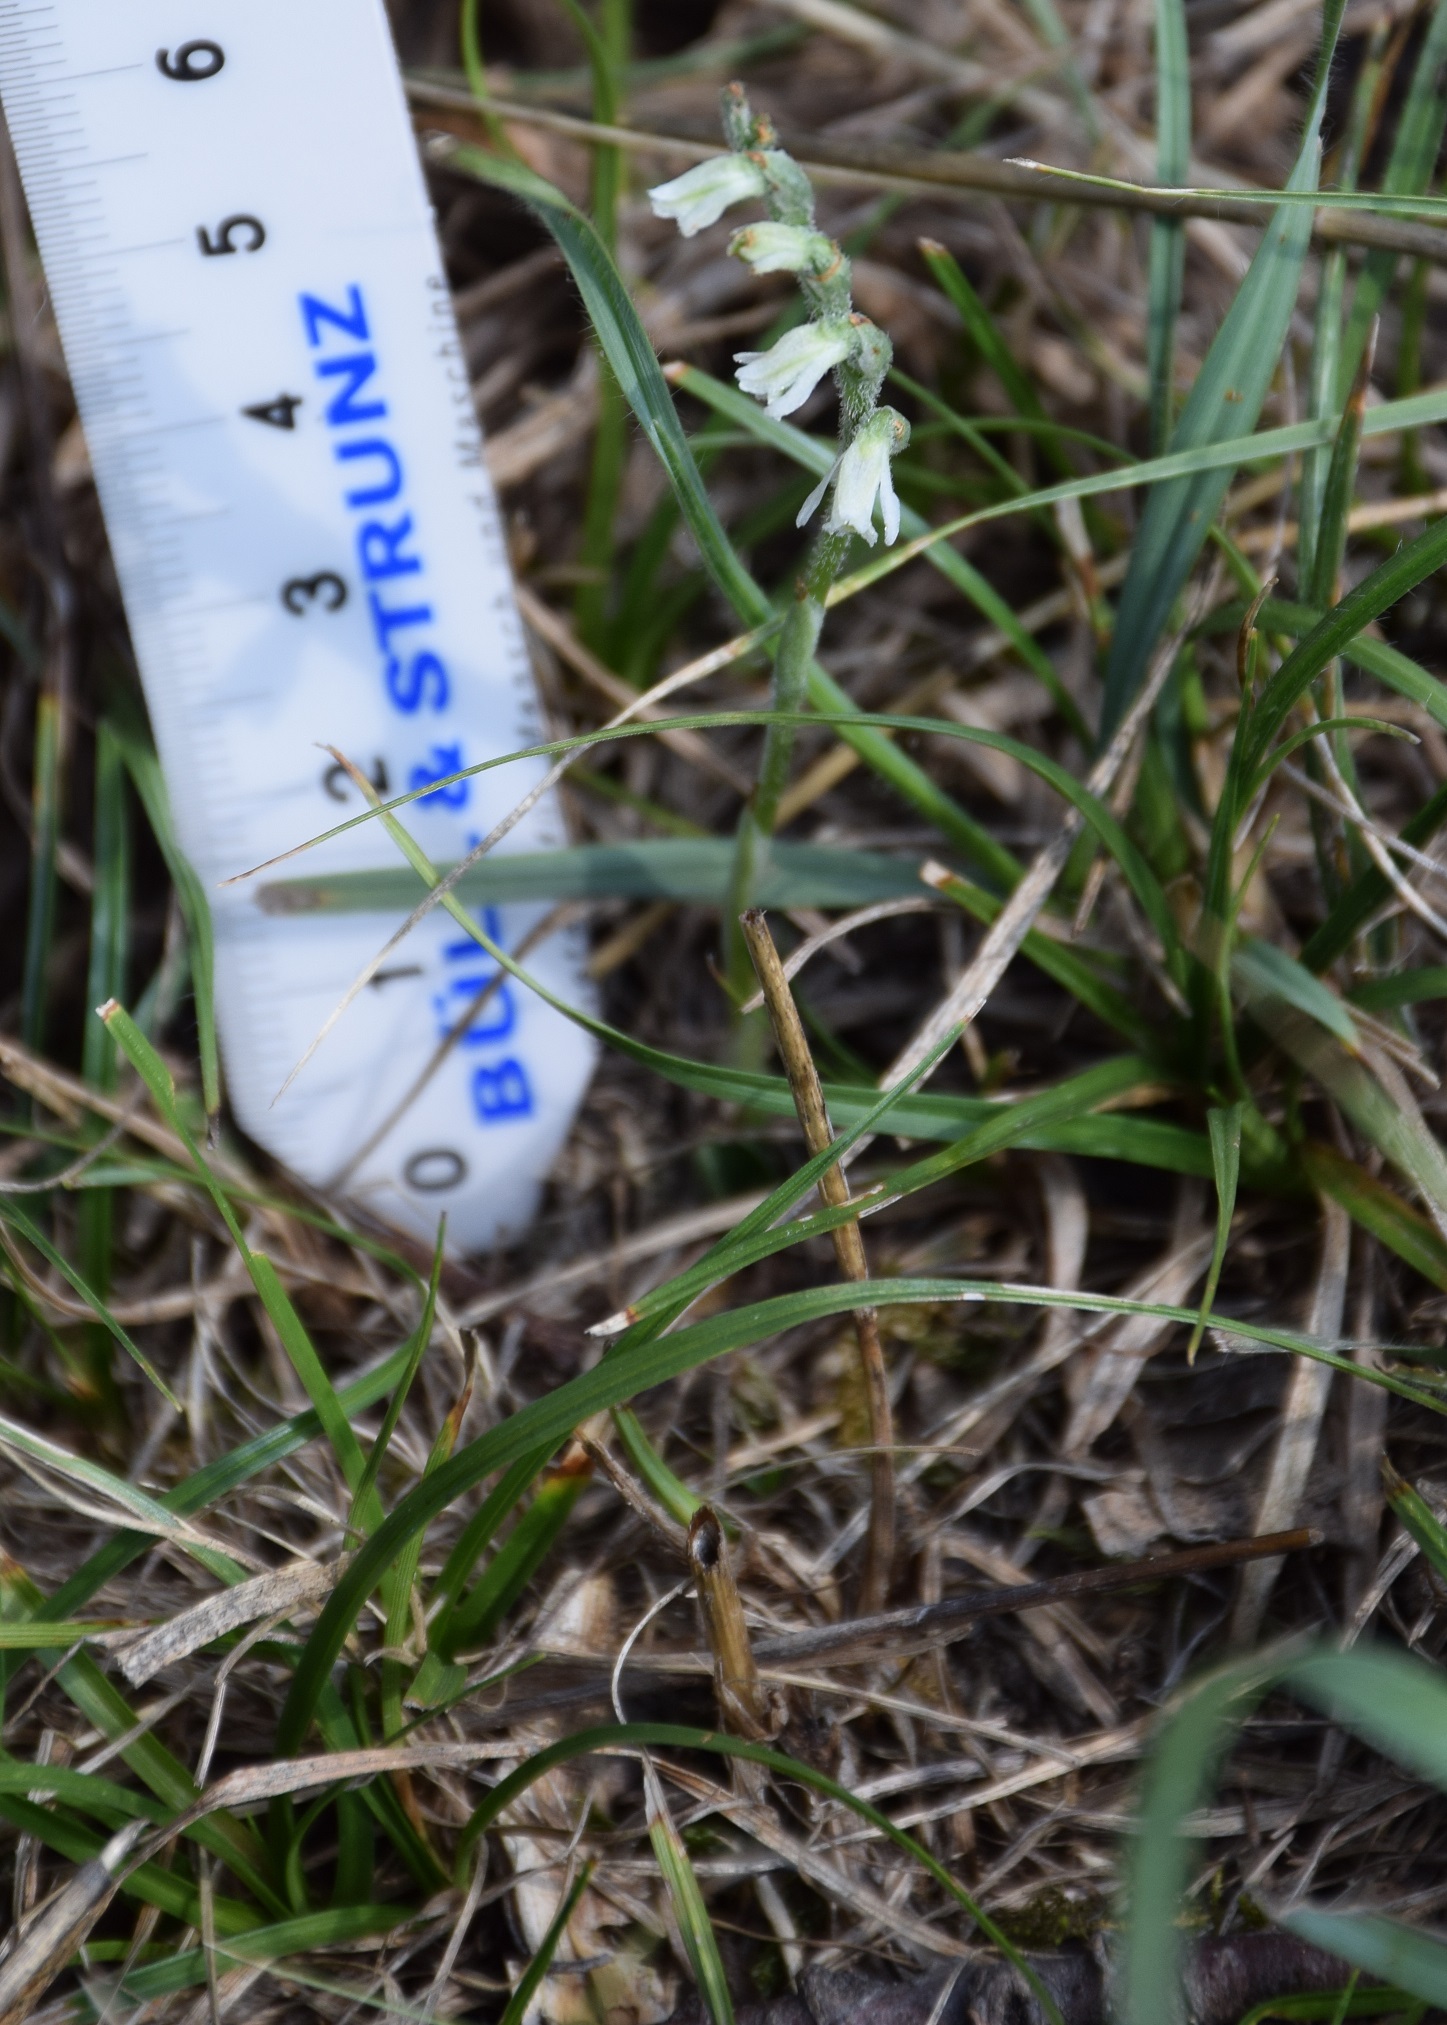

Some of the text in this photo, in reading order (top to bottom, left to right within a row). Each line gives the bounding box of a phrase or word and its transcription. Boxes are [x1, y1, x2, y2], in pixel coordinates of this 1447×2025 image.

[155, 38, 227, 83] 6
[196, 213, 267, 257] 5
[241, 392, 304, 432] 4
[280, 570, 349, 617] 3
[299, 284, 536, 1125] BÜL & STRUNZ
[322, 756, 390, 805] 2
[366, 965, 422, 992] 1
[403, 1148, 468, 1194] 0
